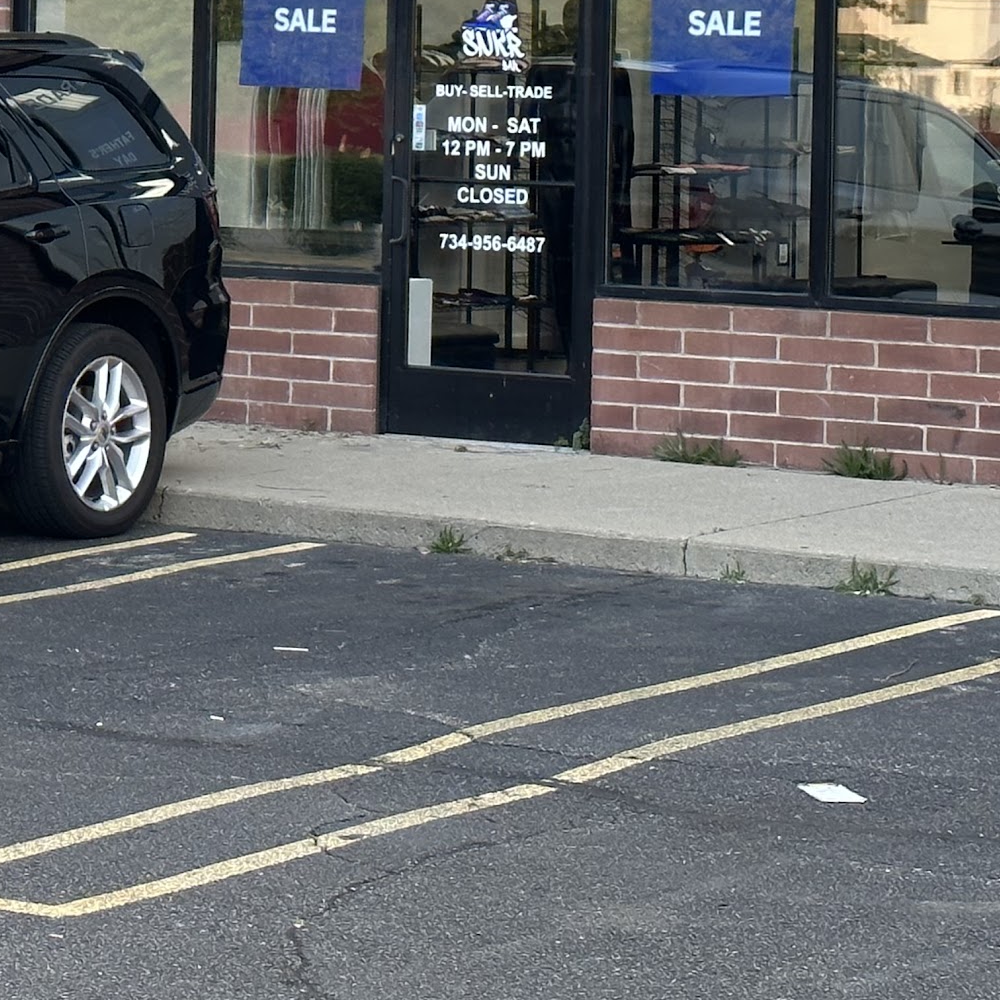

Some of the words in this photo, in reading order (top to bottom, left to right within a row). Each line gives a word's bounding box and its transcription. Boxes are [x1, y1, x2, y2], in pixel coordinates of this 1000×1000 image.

[274, 8, 337, 34] SALE
[688, 10, 762, 37] SALE
[462, 28, 525, 59] SNKR
[448, 116, 487, 132] MON
[507, 117, 541, 134] SAT
[442, 140, 460, 156] 12
[465, 140, 490, 157] PM
[505, 141, 515, 157] 7
[520, 141, 546, 158] PM
[475, 164, 511, 181] SUN
[457, 186, 528, 204] CLOSED
[439, 233, 546, 253] 734-956-6487
